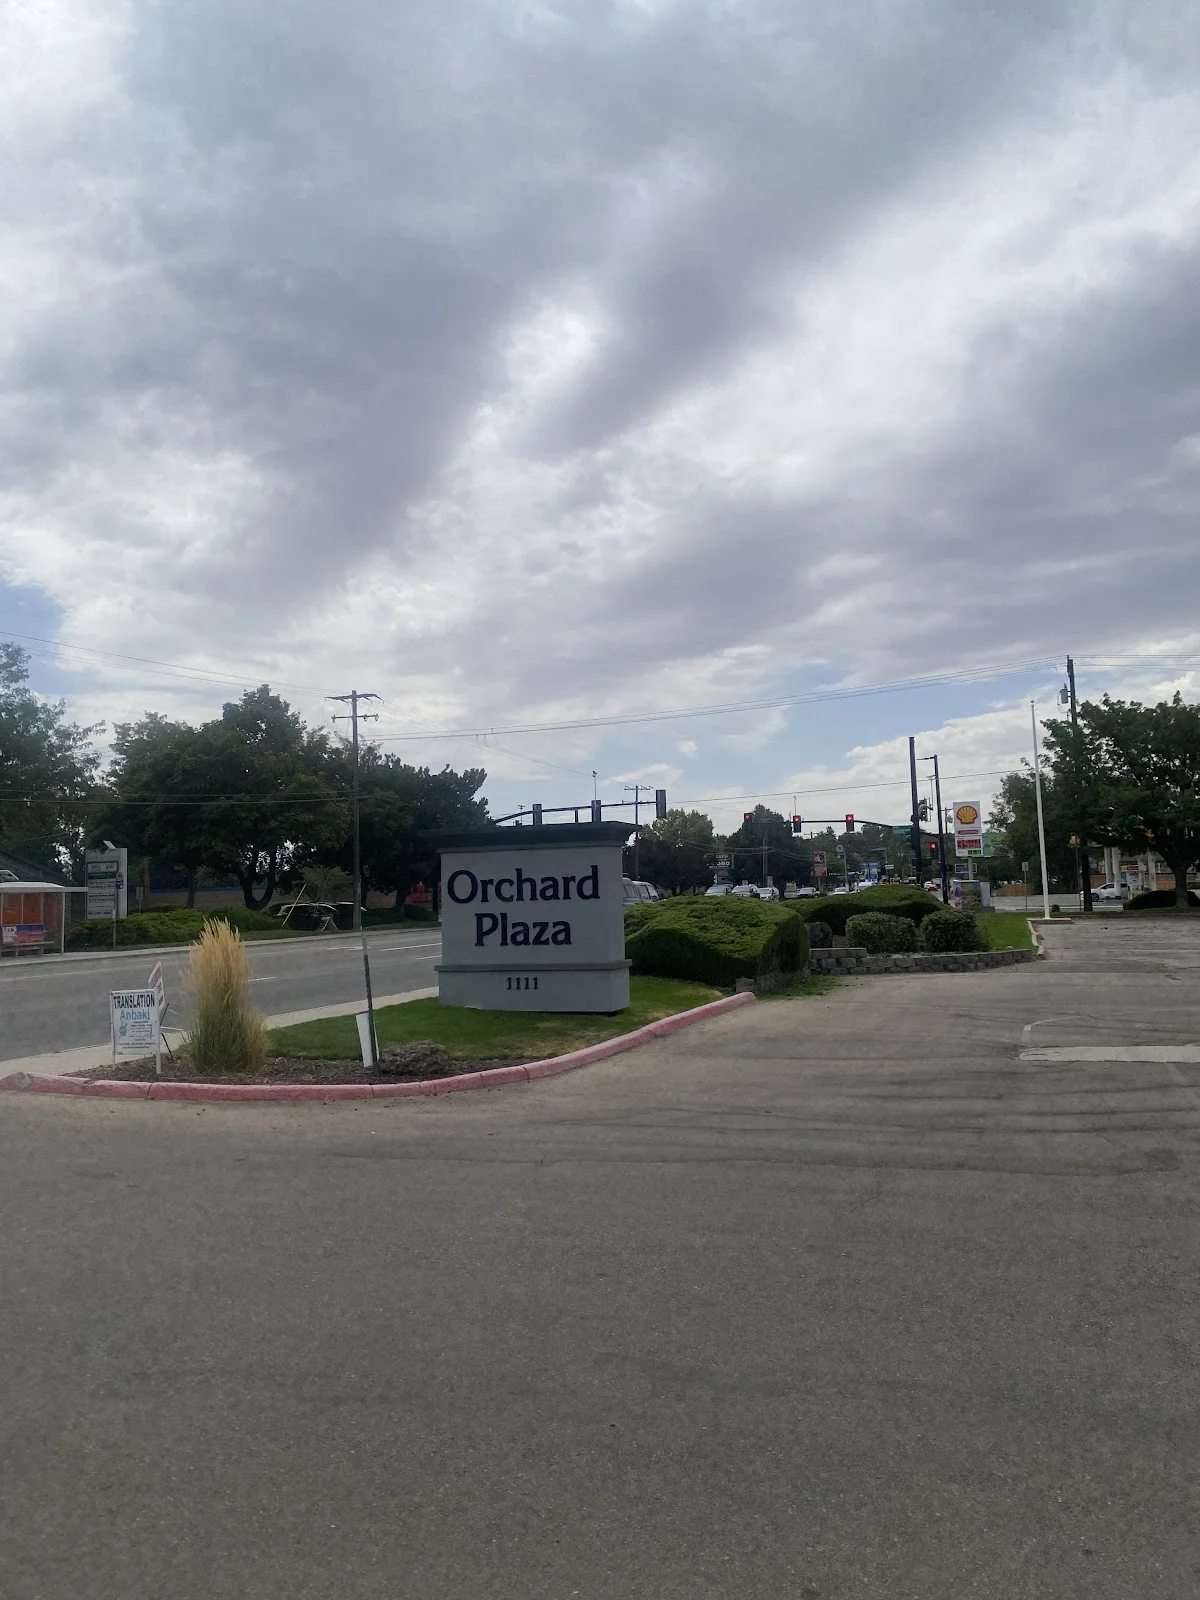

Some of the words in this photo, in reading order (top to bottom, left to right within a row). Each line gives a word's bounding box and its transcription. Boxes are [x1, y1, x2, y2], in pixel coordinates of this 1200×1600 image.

[447, 865, 600, 904] Orchard
[474, 912, 572, 946] Plaza
[506, 976, 539, 990] 1111
[112, 994, 155, 1009] TRANSLATION
[120, 1009, 150, 1020] Anbaki
